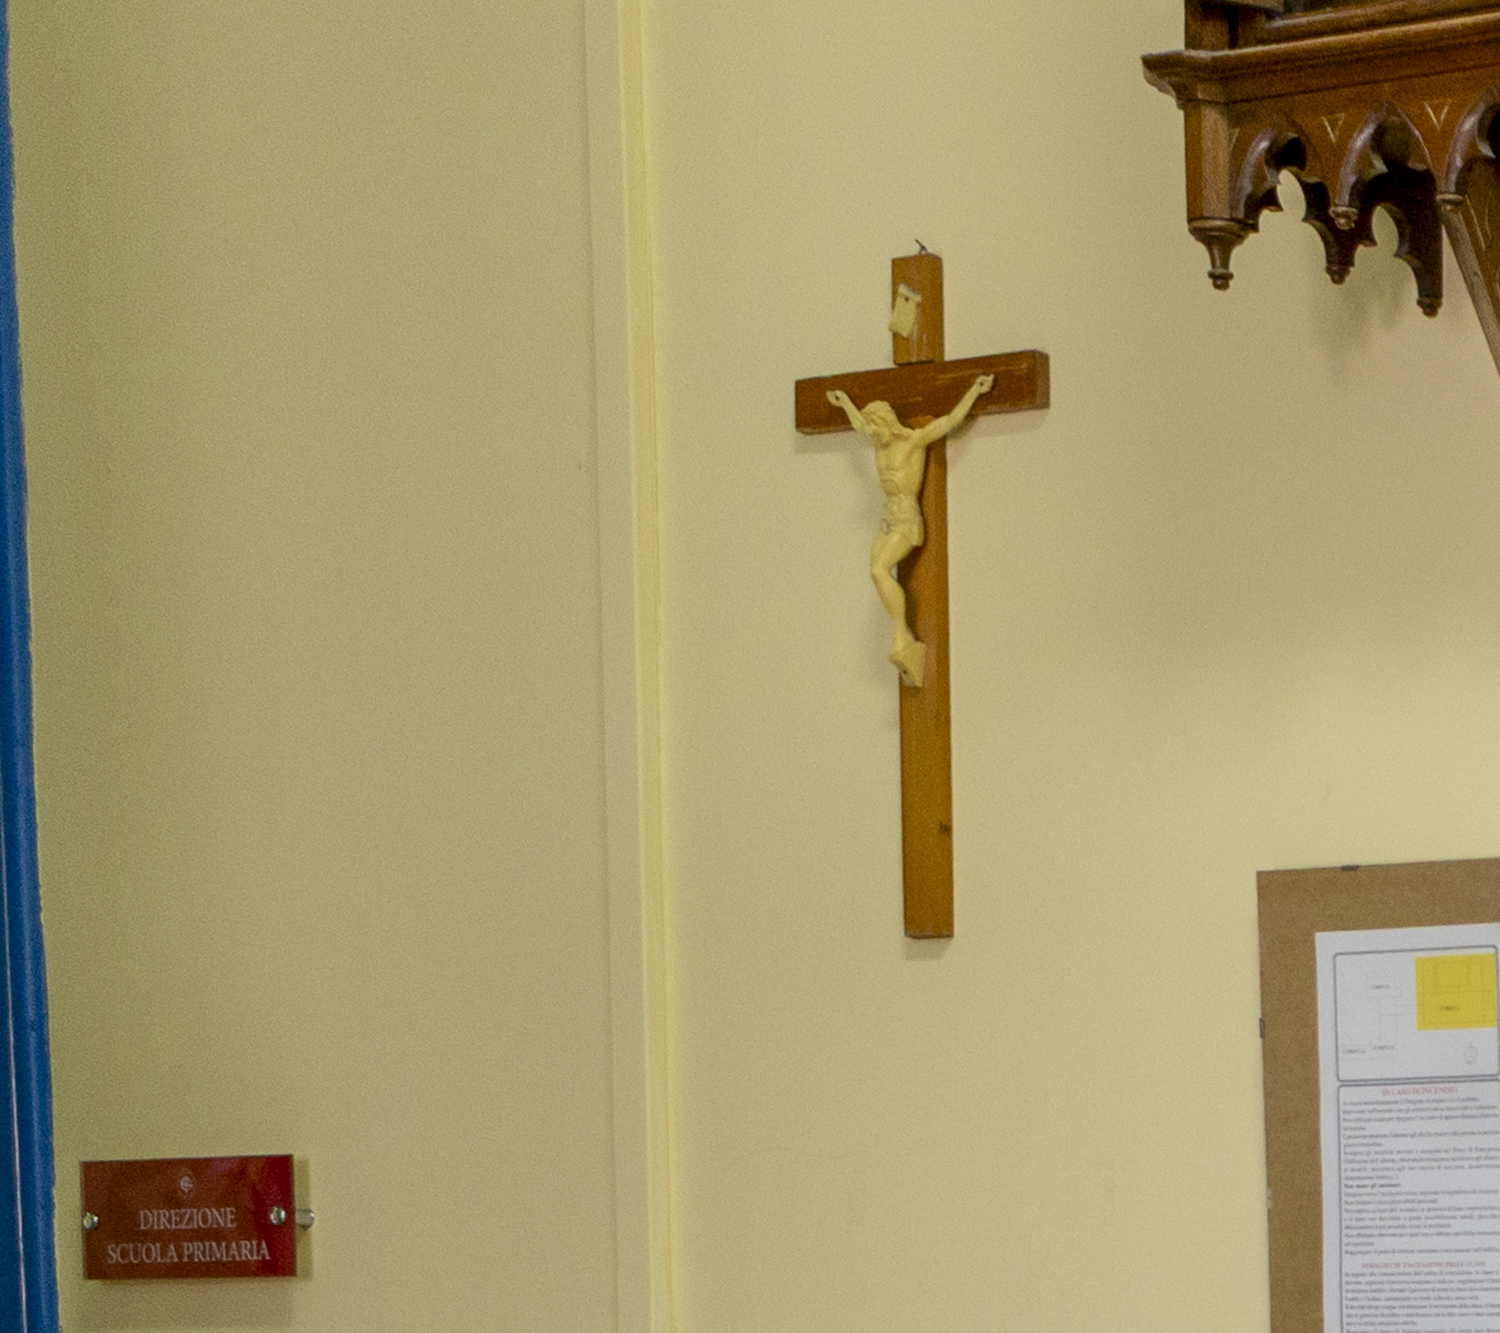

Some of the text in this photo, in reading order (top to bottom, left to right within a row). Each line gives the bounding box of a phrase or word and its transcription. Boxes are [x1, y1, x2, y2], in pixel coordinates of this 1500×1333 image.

[139, 1207, 236, 1231] DIREZIONE
[107, 1239, 271, 1264] SCUOLA PRIMARIA
